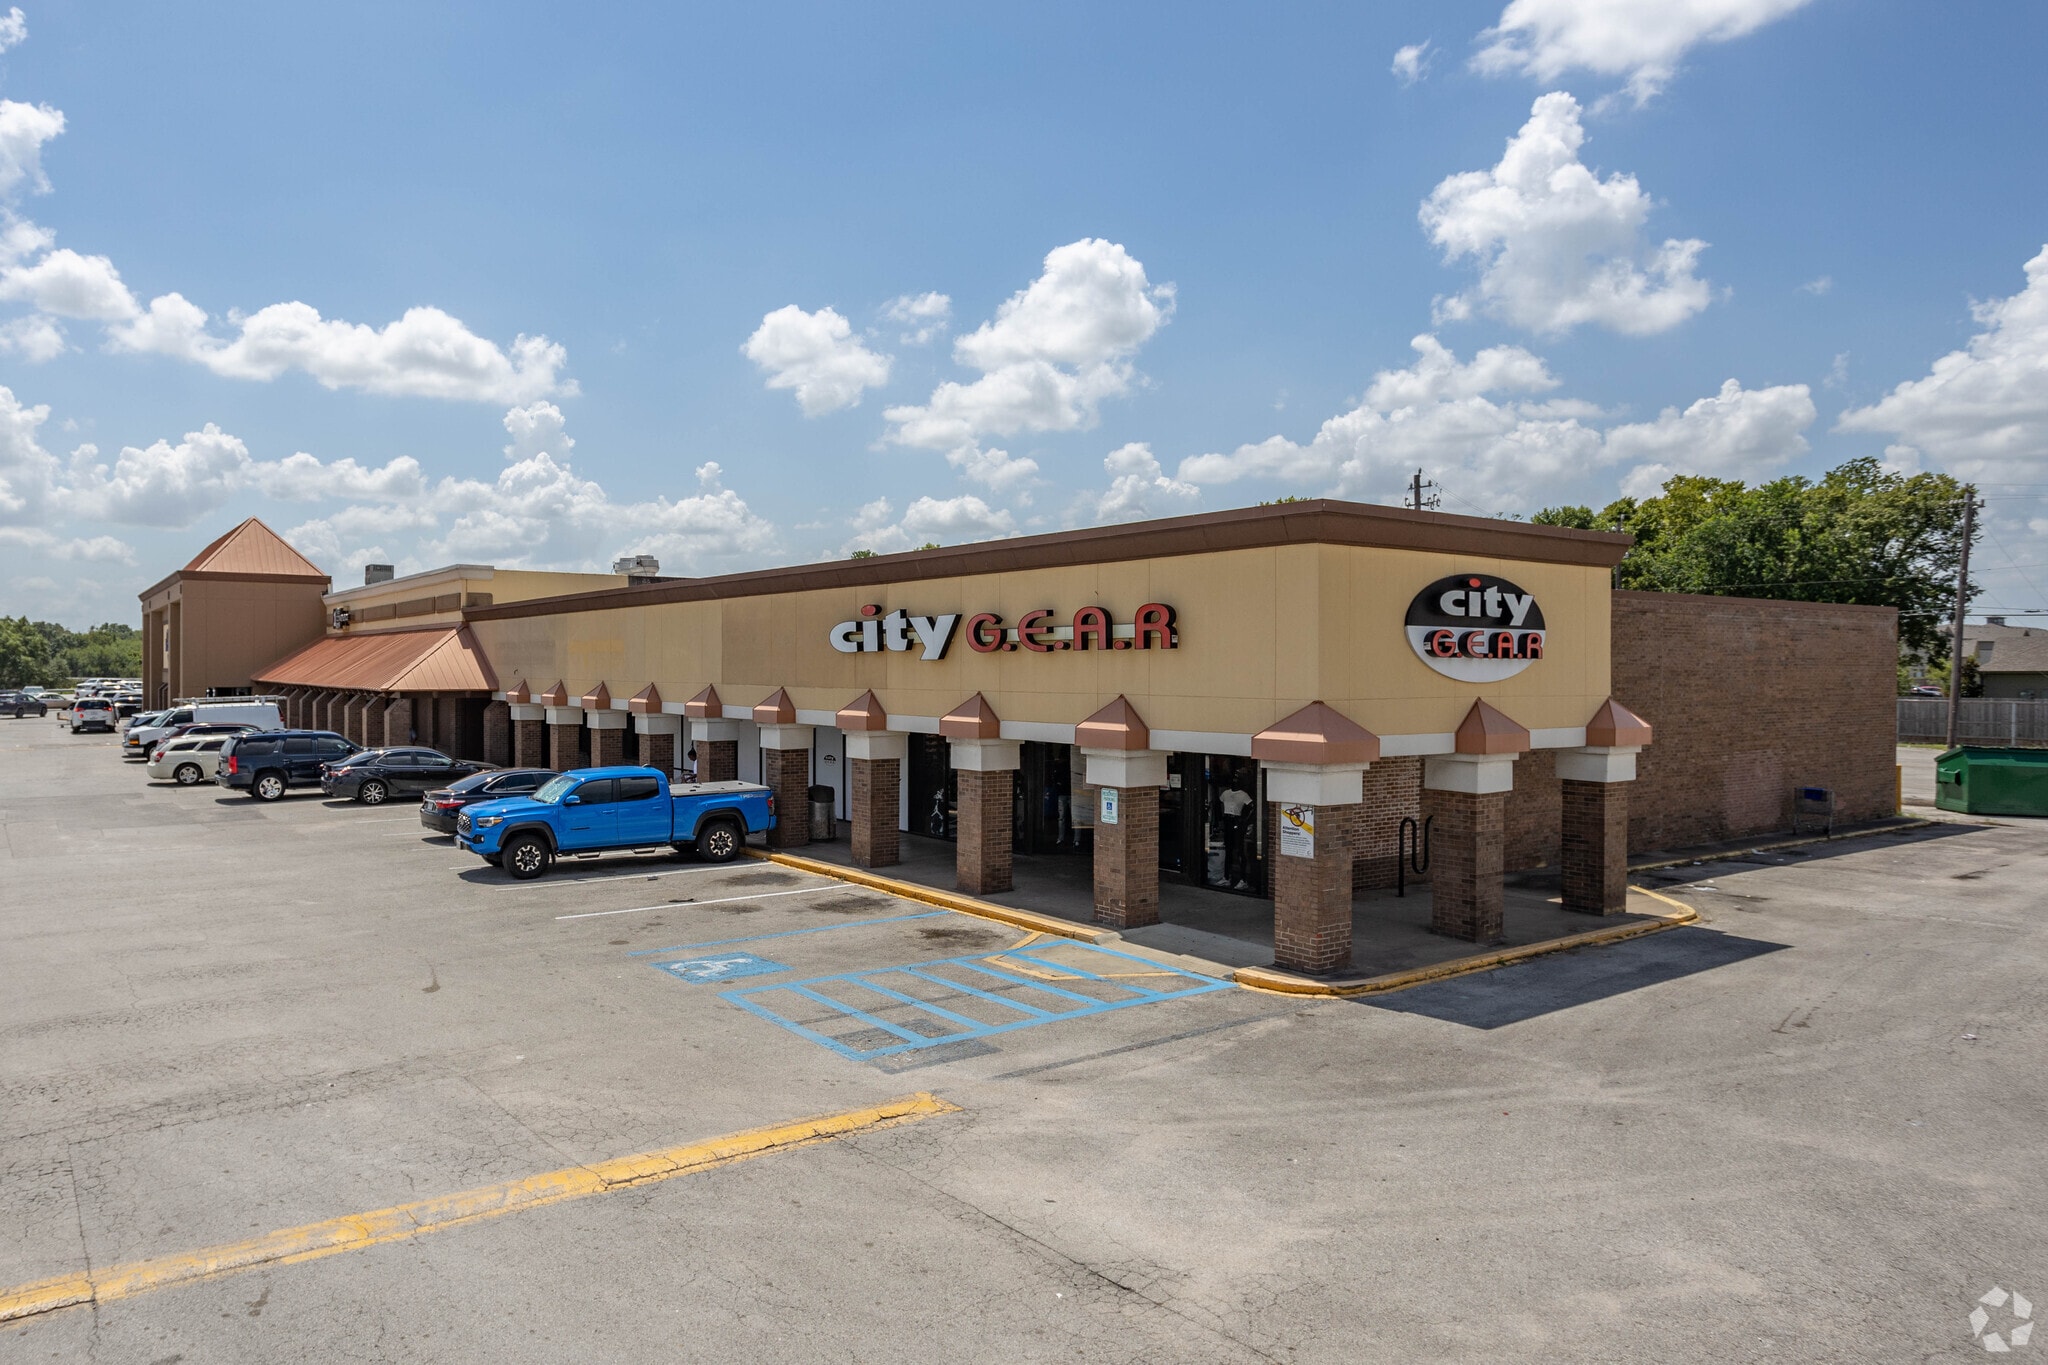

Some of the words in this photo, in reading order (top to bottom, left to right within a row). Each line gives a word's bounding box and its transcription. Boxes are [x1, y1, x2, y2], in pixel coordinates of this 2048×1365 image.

[1440, 578, 1535, 626] city
[829, 604, 962, 661] city
[966, 603, 1178, 652] G.E.A.R
[1425, 629, 1543, 659] G.E.A.R
